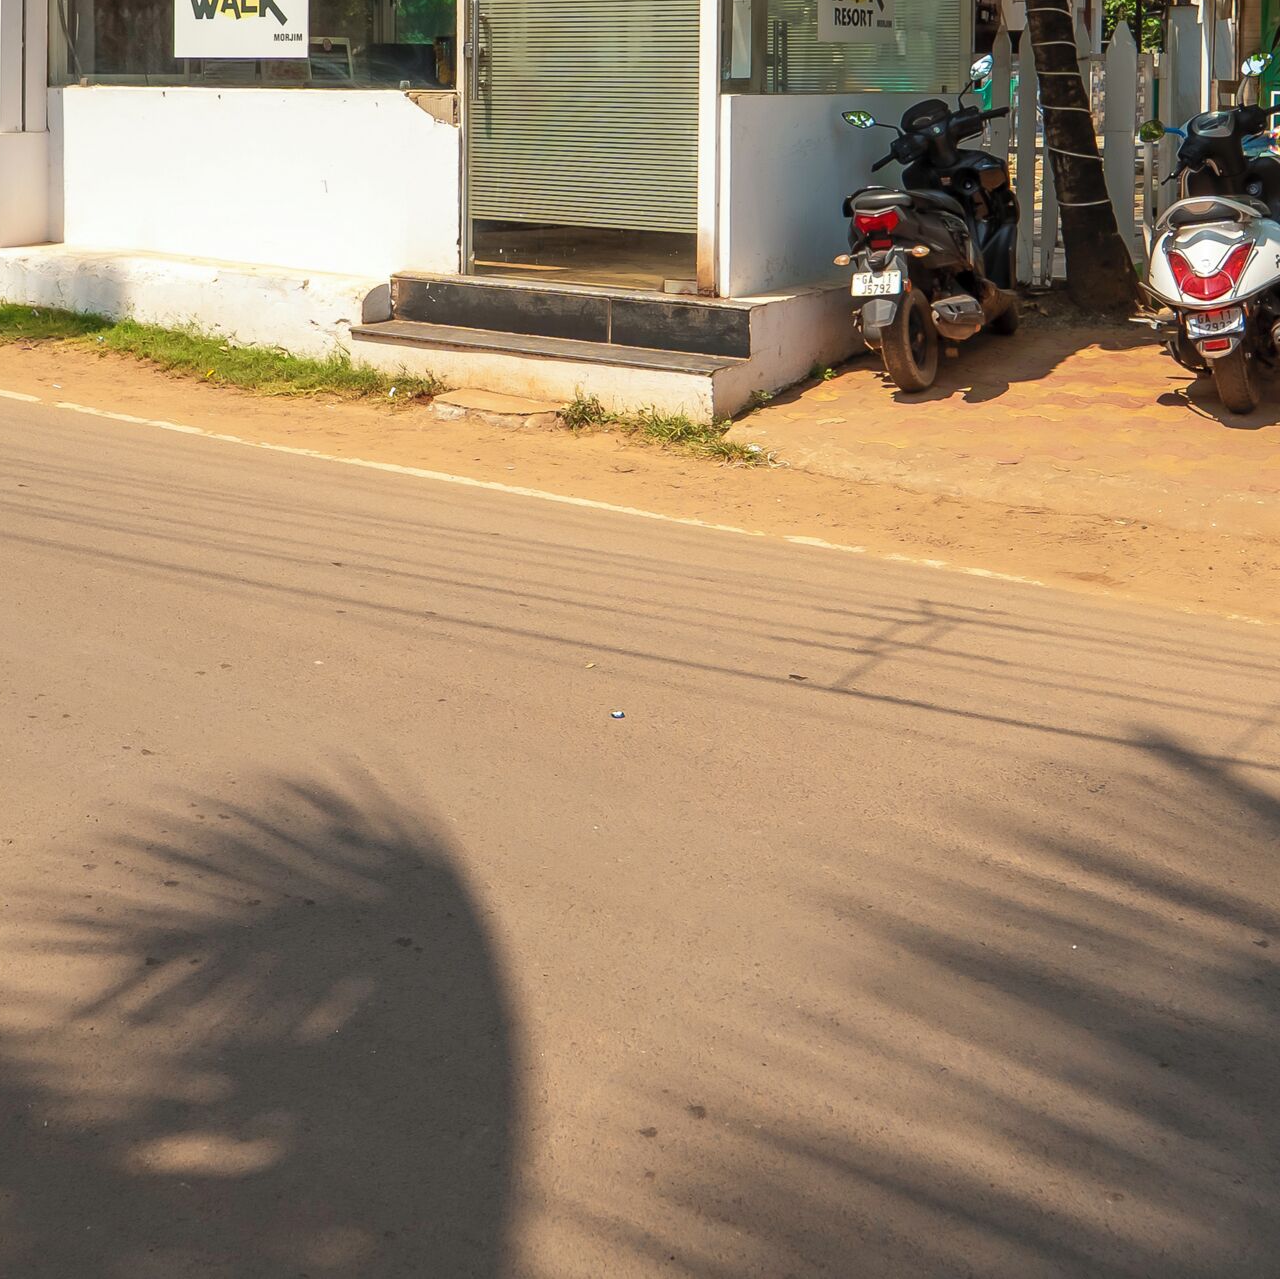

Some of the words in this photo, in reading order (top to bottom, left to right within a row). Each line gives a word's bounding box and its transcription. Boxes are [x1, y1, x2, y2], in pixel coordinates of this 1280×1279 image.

[835, 8, 873, 27] RESORT
[274, 33, 303, 41] MORJIM
[862, 275, 873, 284] GA
[862, 284, 891, 294] J5792
[1198, 314, 1211, 324] GA
